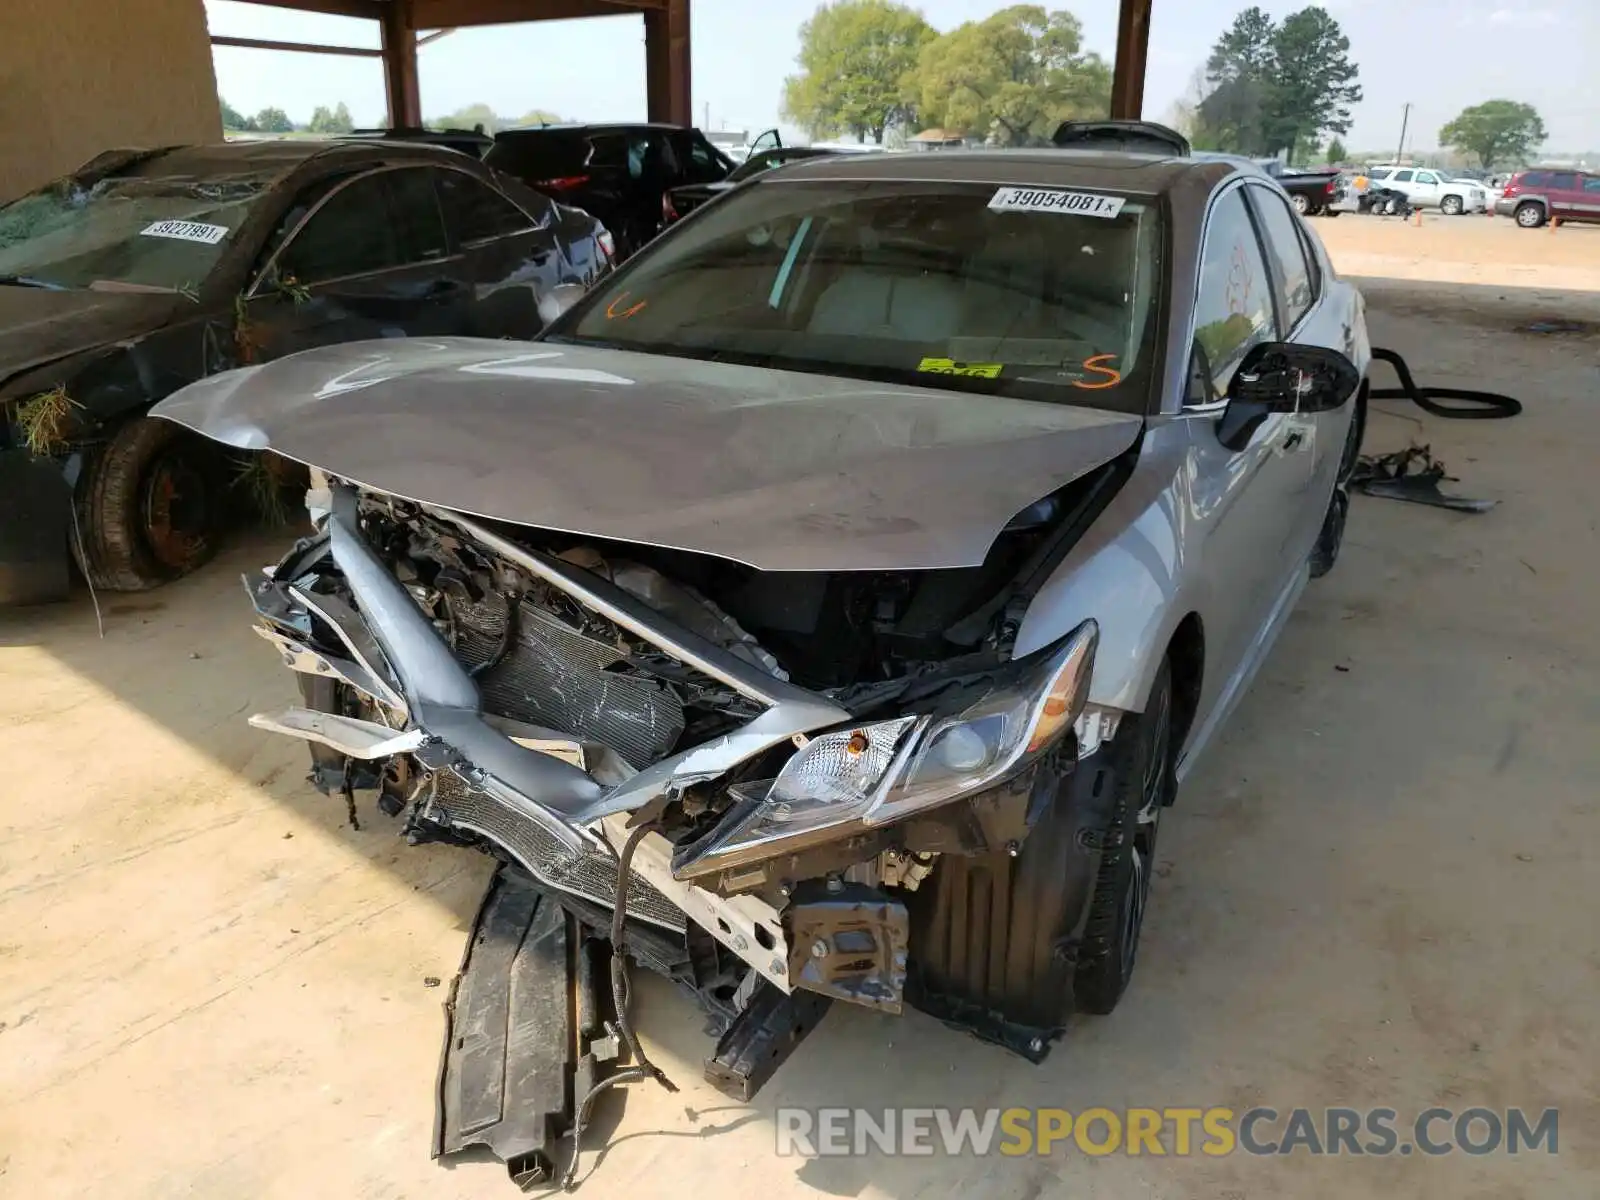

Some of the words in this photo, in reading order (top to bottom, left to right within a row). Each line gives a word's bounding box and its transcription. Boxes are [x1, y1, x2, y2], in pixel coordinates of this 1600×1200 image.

[1007, 190, 1104, 212] 39054081
[153, 222, 216, 239] 39227991
[1072, 353, 1121, 389] S
